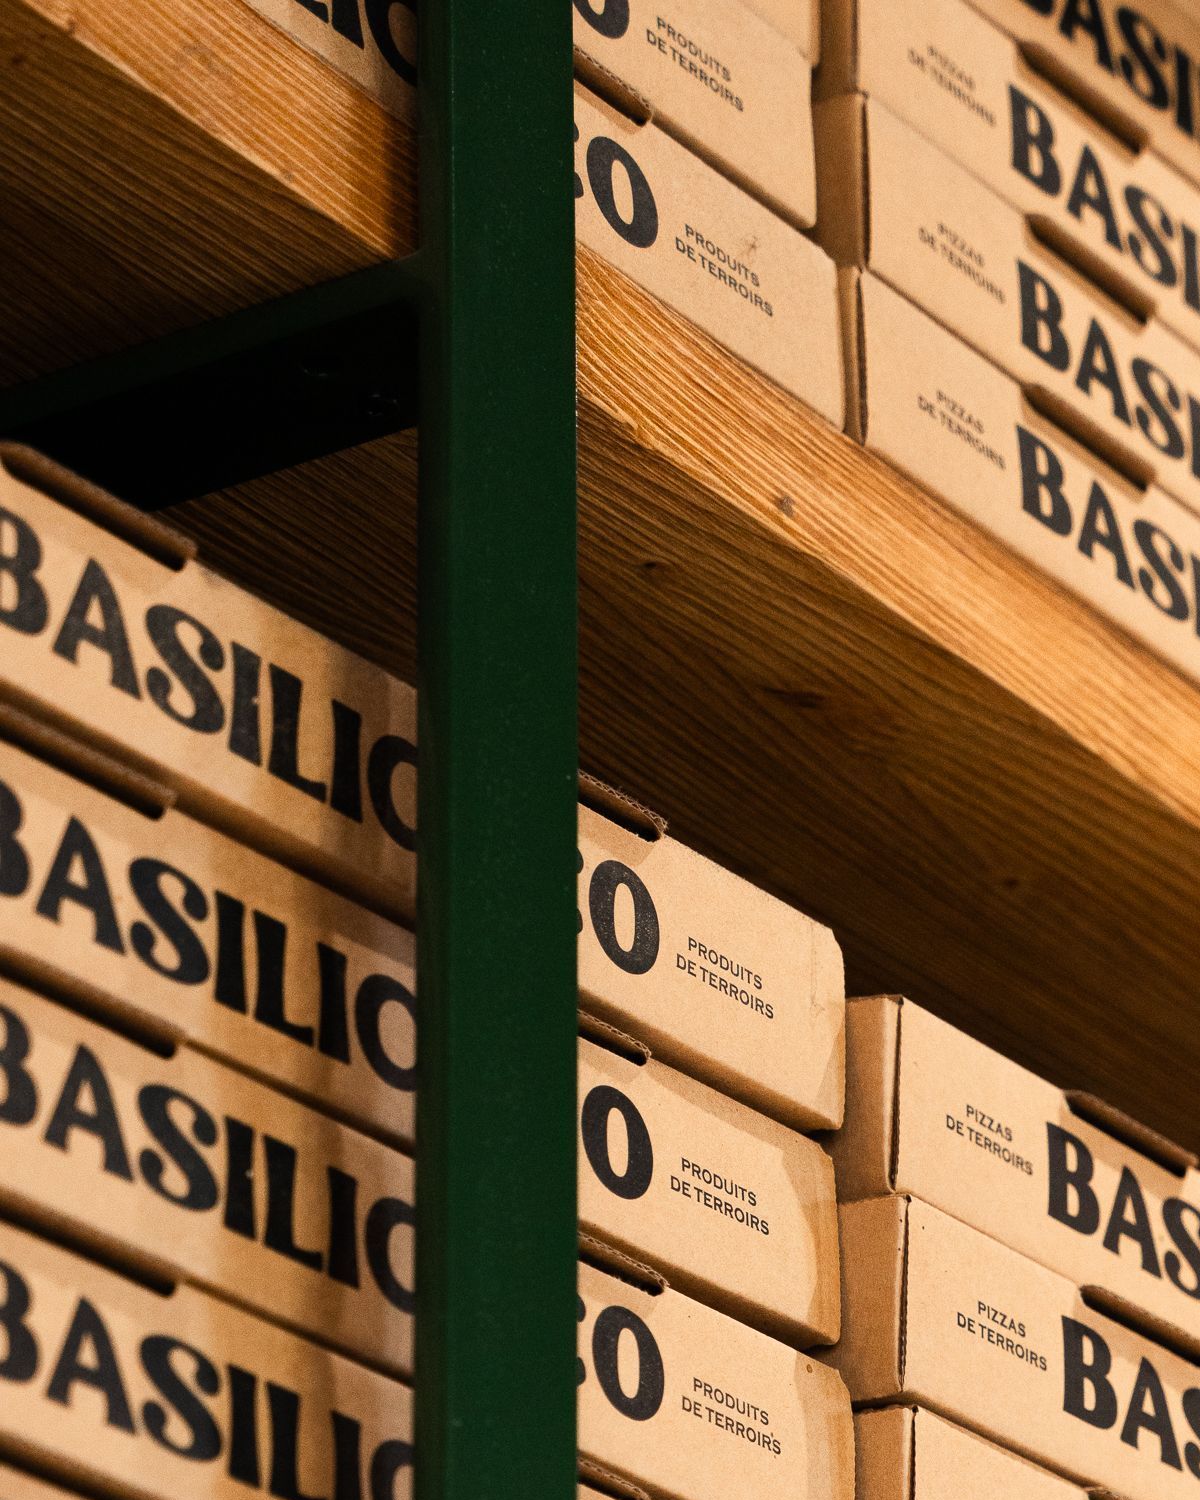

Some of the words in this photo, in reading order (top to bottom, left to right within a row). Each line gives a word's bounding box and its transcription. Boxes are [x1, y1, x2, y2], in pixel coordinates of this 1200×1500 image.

[646, 29, 667, 54] DE
[672, 46, 743, 112] TERROIRS
[657, 17, 731, 81] PRODUITS
[675, 237, 697, 262] DE
[701, 254, 773, 317] TERROIRS
[685, 224, 760, 287] PRODUITS
[676, 954, 696, 977] DE
[700, 966, 773, 1019] TERROIRS
[688, 937, 763, 990] PRODUITS
[946, 1115, 964, 1136] DE
[967, 1127, 1033, 1175] TERROIRS
[967, 1104, 1012, 1141] PIZZAS
[670, 1176, 691, 1198] DE
[694, 1189, 769, 1235] TERROIRS
[681, 1158, 756, 1206] PRODUITS
[957, 1312, 976, 1333] DE
[980, 1323, 1047, 1371] TERROIRS
[978, 1301, 1025, 1337] PIZZAS
[682, 1396, 702, 1418] DE
[705, 1407, 781, 1454] TERROIRS
[693, 1378, 769, 1426] PRODUITS
